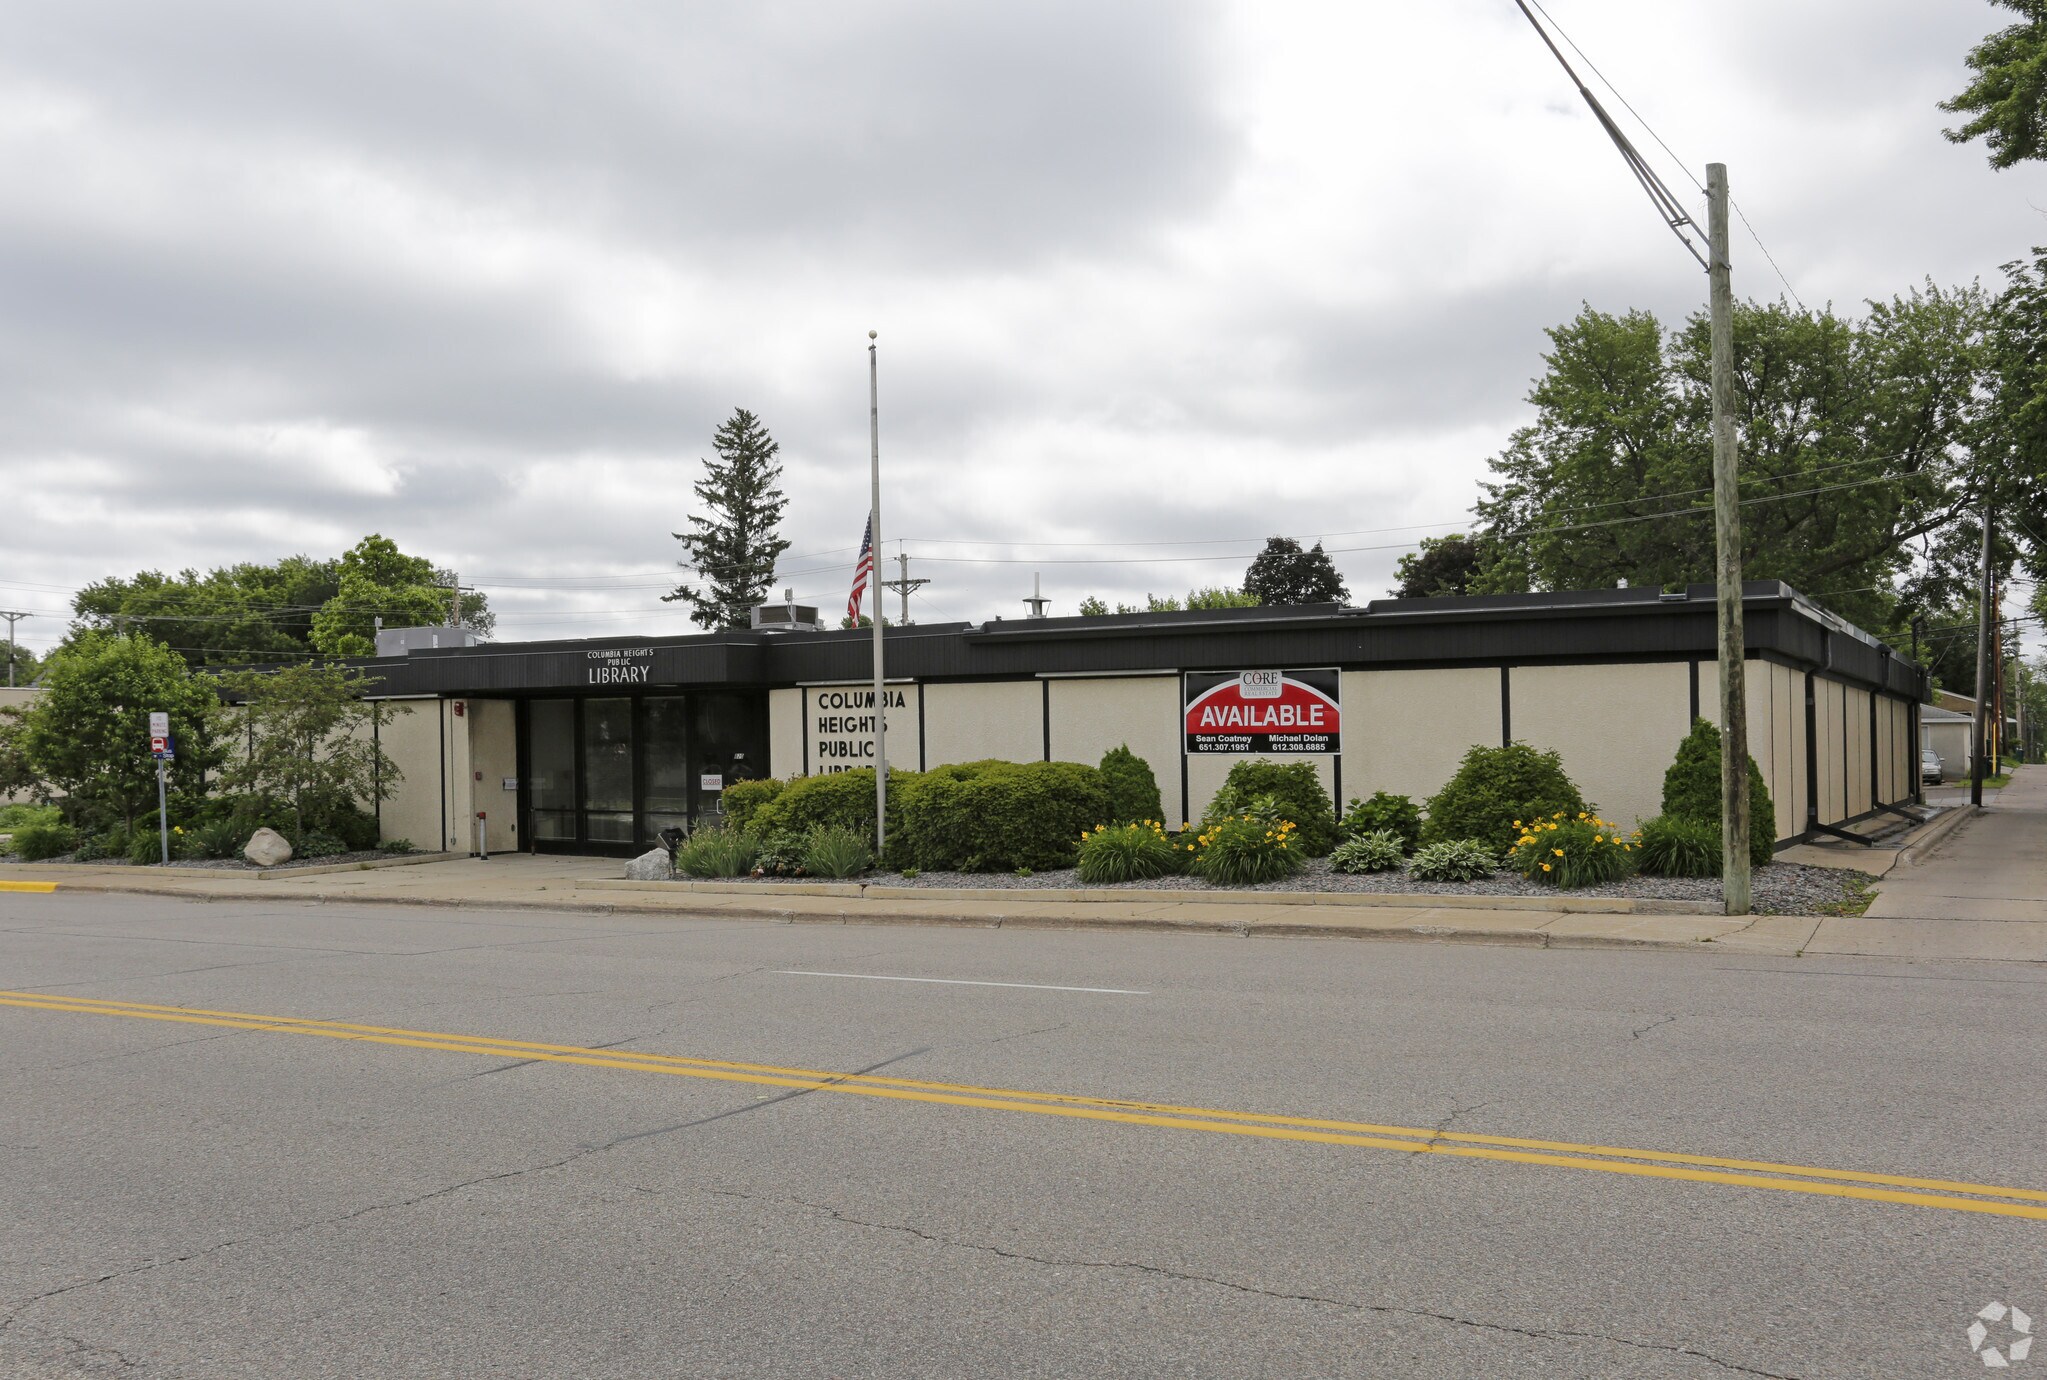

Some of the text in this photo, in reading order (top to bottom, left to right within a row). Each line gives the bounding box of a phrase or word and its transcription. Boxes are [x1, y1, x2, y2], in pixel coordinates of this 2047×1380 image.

[587, 648, 654, 659] COLUMBIA HEIGHTS
[607, 658, 631, 666] PUBLIC
[589, 665, 650, 684] LIBRARY
[1243, 671, 1278, 685] CORE
[1200, 704, 1324, 727] AVAILABLE
[1217, 735, 1252, 744] Coatney
[1269, 734, 1328, 742] Michael Dolan
[819, 741, 874, 758] PUBLIC
[1198, 743, 1249, 751] 651.307.1951
[1272, 743, 1326, 751] 612.308.6885
